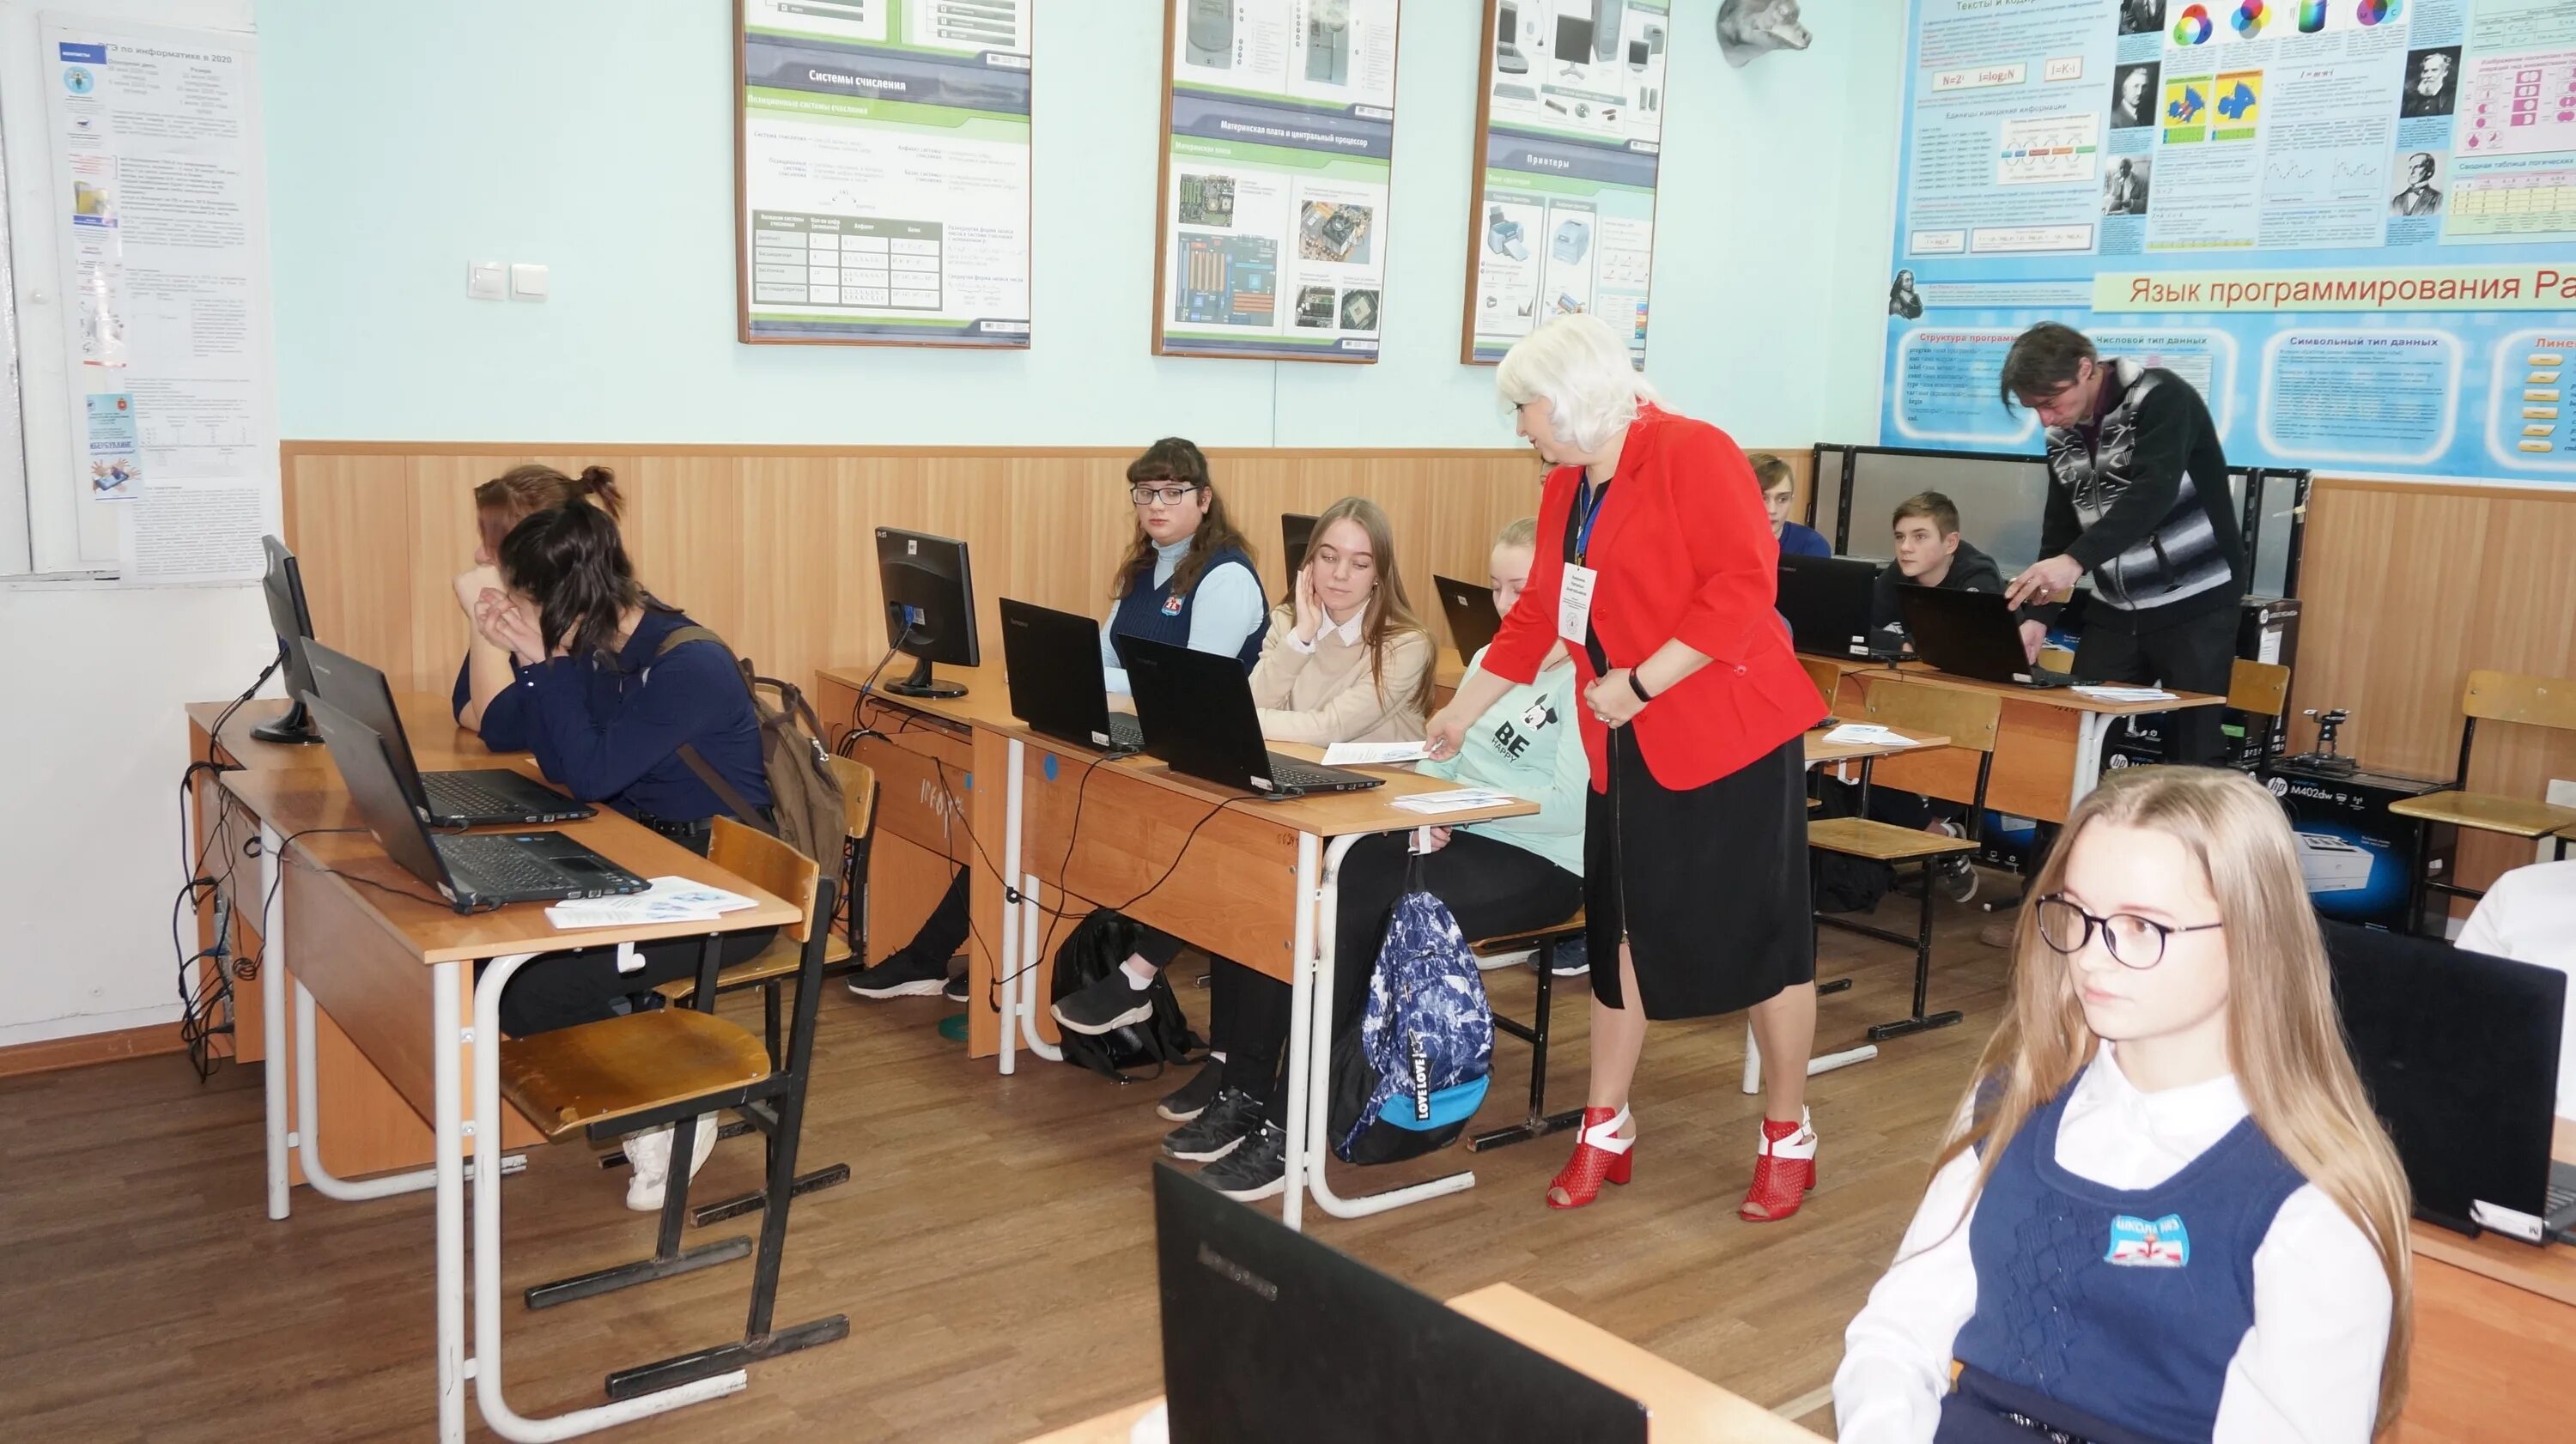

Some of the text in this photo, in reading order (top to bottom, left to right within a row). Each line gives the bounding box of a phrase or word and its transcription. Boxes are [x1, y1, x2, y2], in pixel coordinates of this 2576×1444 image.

[211, 54, 233, 64] 2020
[809, 70, 906, 92] Системы счисления
[1220, 119, 1265, 134] Материнская
[1266, 126, 1285, 137] плата
[1291, 130, 1334, 143] центральный
[1335, 137, 1368, 149] процессор
[1527, 154, 1571, 169] Принтеры
[2129, 277, 2201, 303] Язык
[2210, 276, 2521, 308] программирования
[1919, 332, 1967, 343] Структура
[2095, 335, 2145, 345] Числовой
[2166, 337, 2208, 346] данных
[2289, 337, 2439, 348] Символьный тип данных
[2536, 337, 2576, 349] Лине
[1494, 720, 1531, 759] BE
[1491, 737, 1518, 764] HAPPY
[2269, 777, 2287, 798] hp
[2290, 785, 2333, 800] M402dw
[1414, 1059, 1429, 1119] LOVE LOVE
